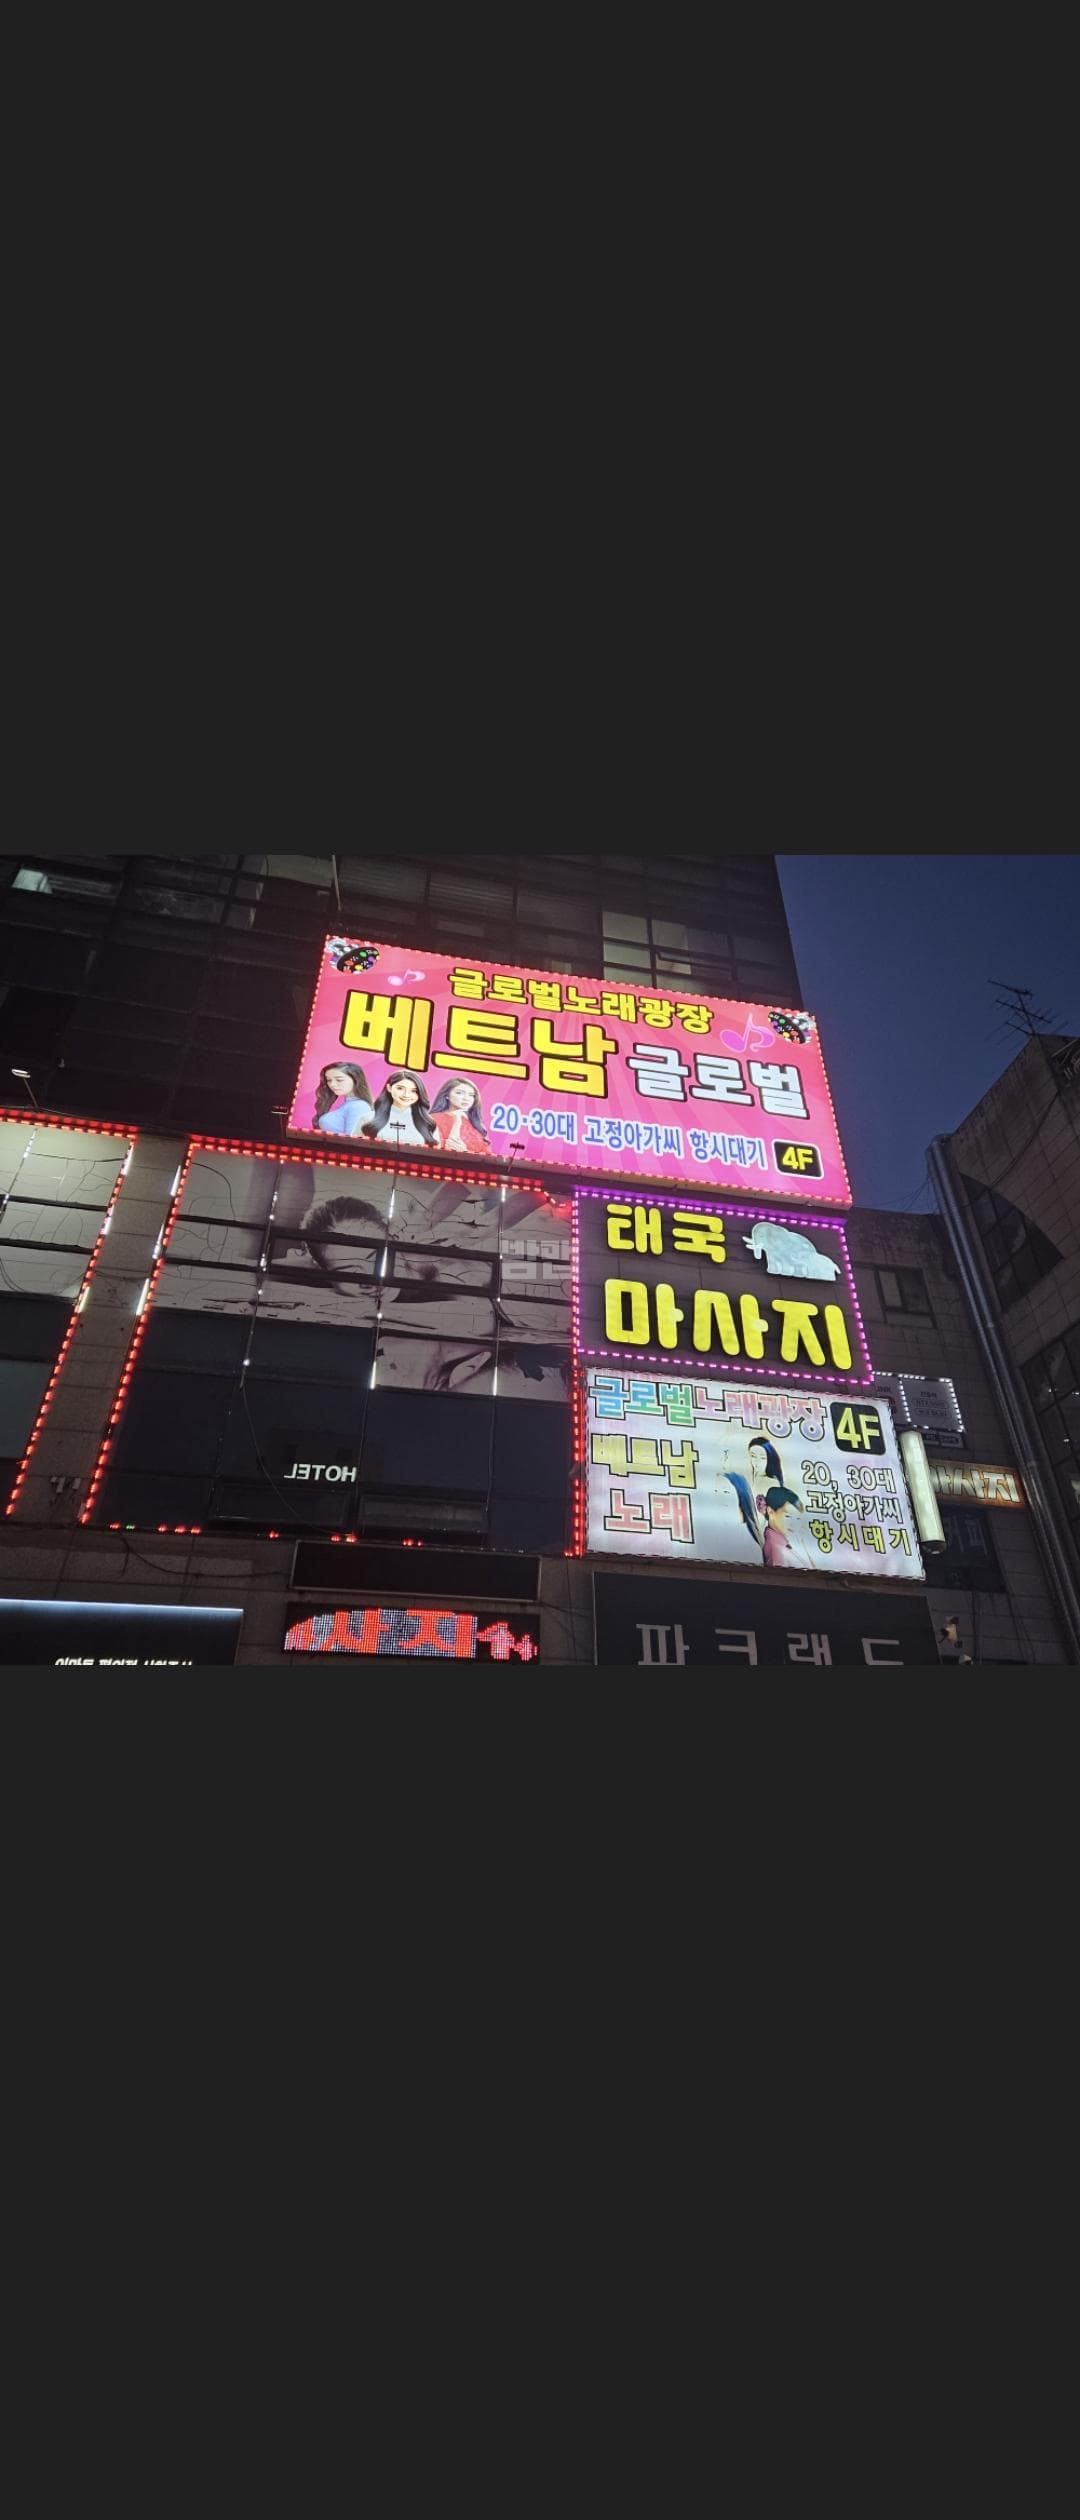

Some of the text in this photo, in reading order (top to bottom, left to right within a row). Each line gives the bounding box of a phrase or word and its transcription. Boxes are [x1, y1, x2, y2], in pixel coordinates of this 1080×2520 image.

[448, 966, 715, 1034] 글로벌노래광장
[340, 990, 810, 1120] 베트남 글로벌
[584, 1115, 682, 1159] 고정아가씨
[690, 1131, 767, 1169] 항시대기
[781, 1145, 814, 1171] 4F
[606, 1203, 726, 1264] 태국
[604, 1278, 852, 1370] 마사지
[588, 1374, 829, 1442] 글로벌노래광장
[834, 1406, 882, 1451] 4F
[590, 1433, 699, 1489] 베트남
[848, 1464, 898, 1494] 30대
[604, 1487, 695, 1544] 노래
[805, 1489, 905, 1524] 고정아가씨
[809, 1518, 913, 1557] 항시대기
